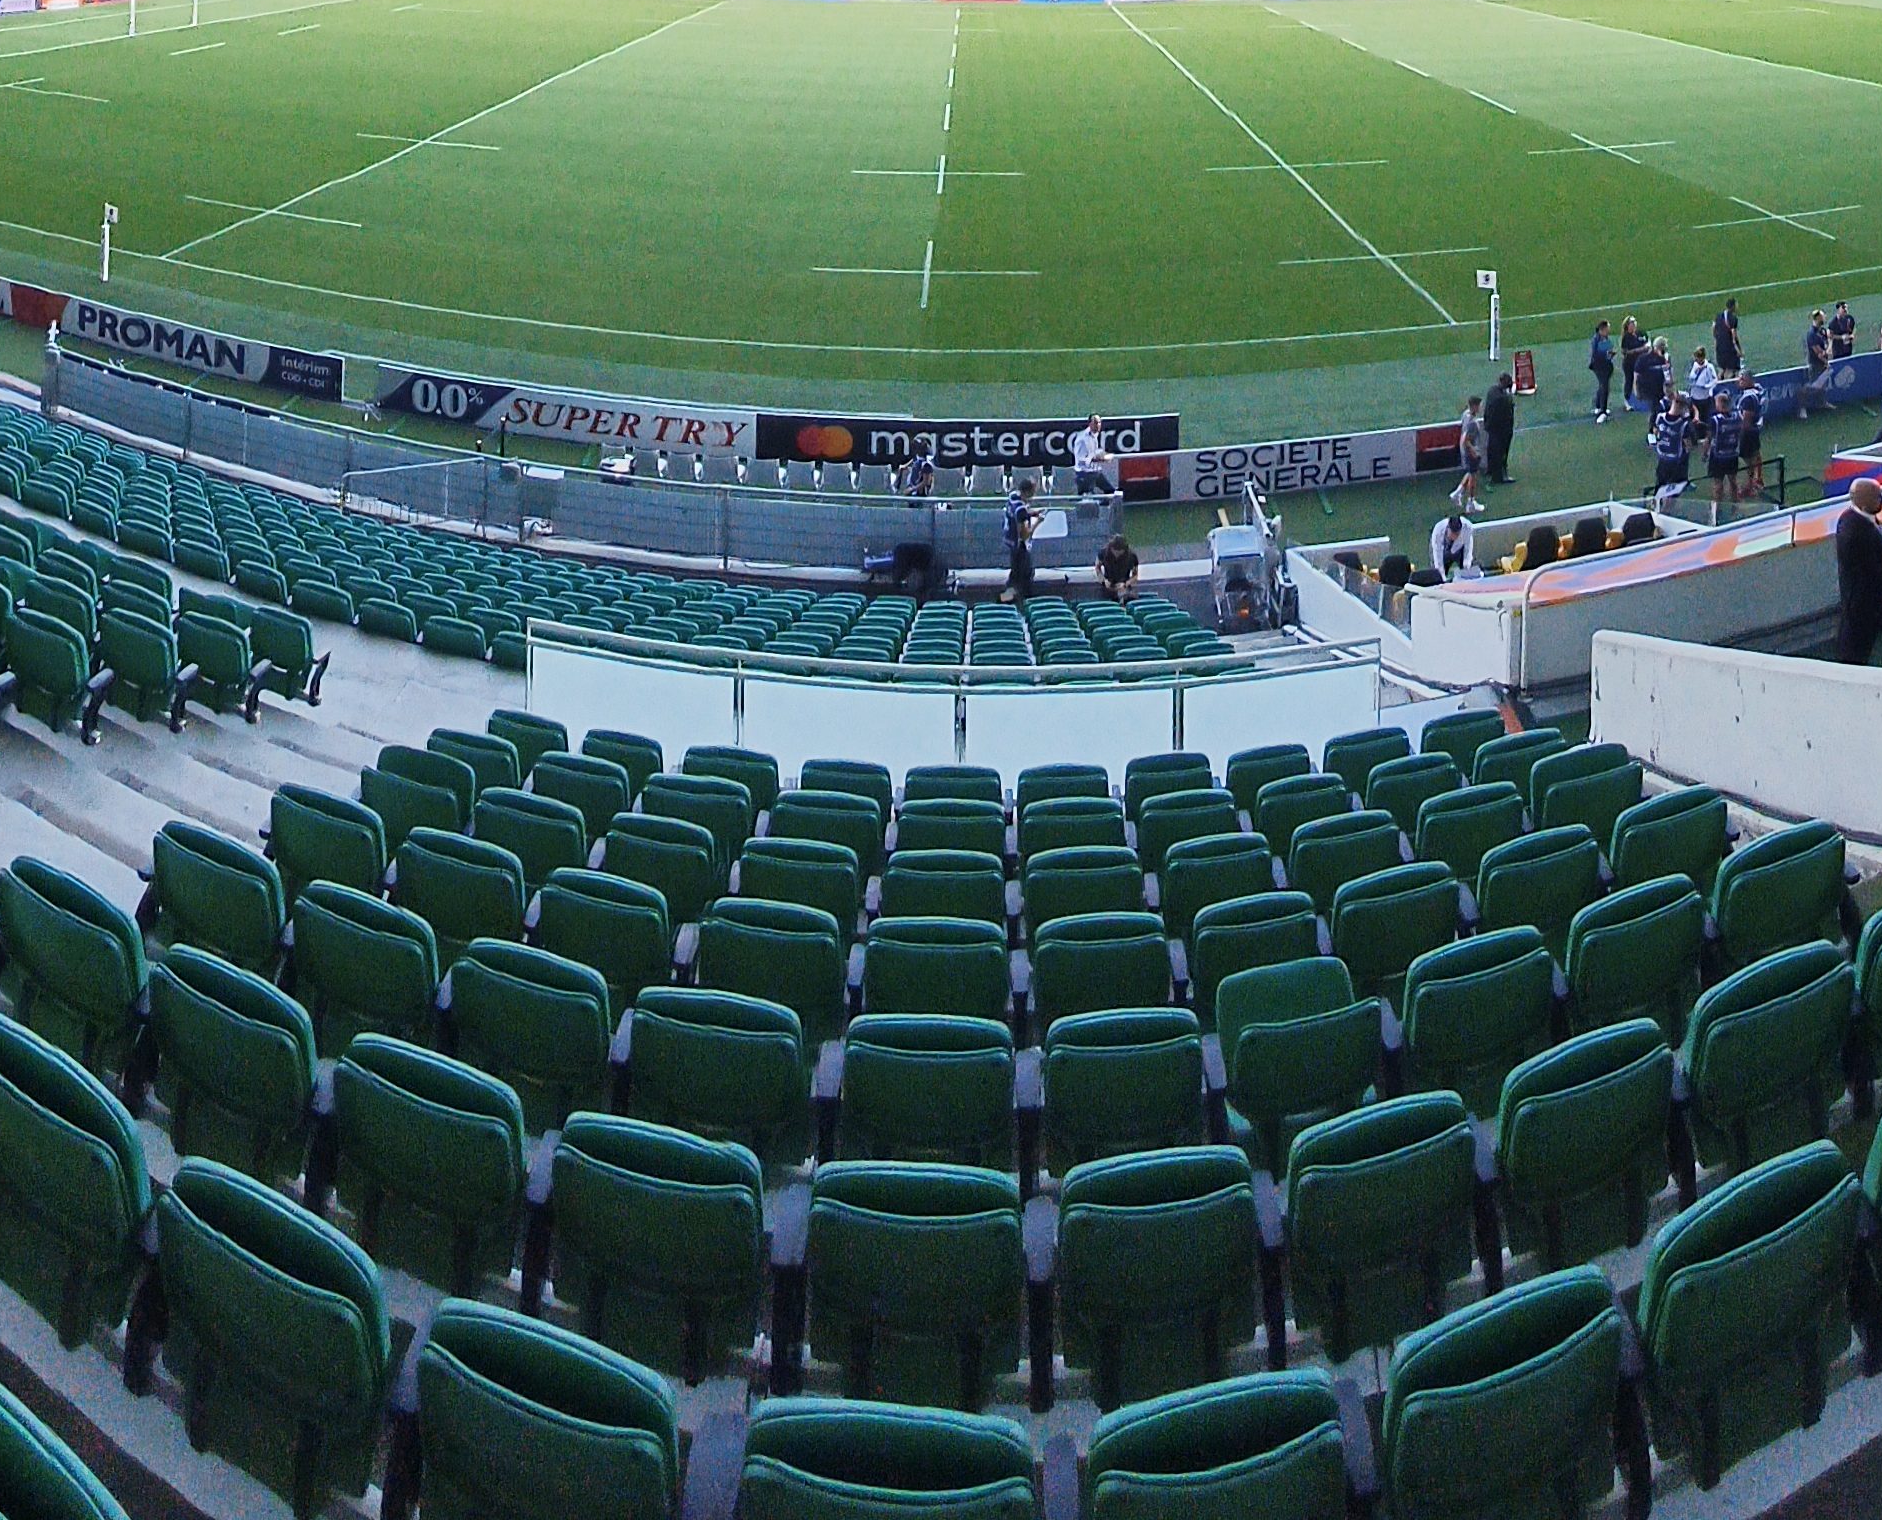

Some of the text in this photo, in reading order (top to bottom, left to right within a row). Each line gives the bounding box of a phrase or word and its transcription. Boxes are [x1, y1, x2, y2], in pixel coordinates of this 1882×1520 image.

[78, 304, 246, 376] PROMAN
[506, 396, 641, 439] SUPER
[653, 414, 749, 448] TRY
[1194, 456, 1392, 499] GENERALE
[1195, 436, 1352, 474] SOCIETE
